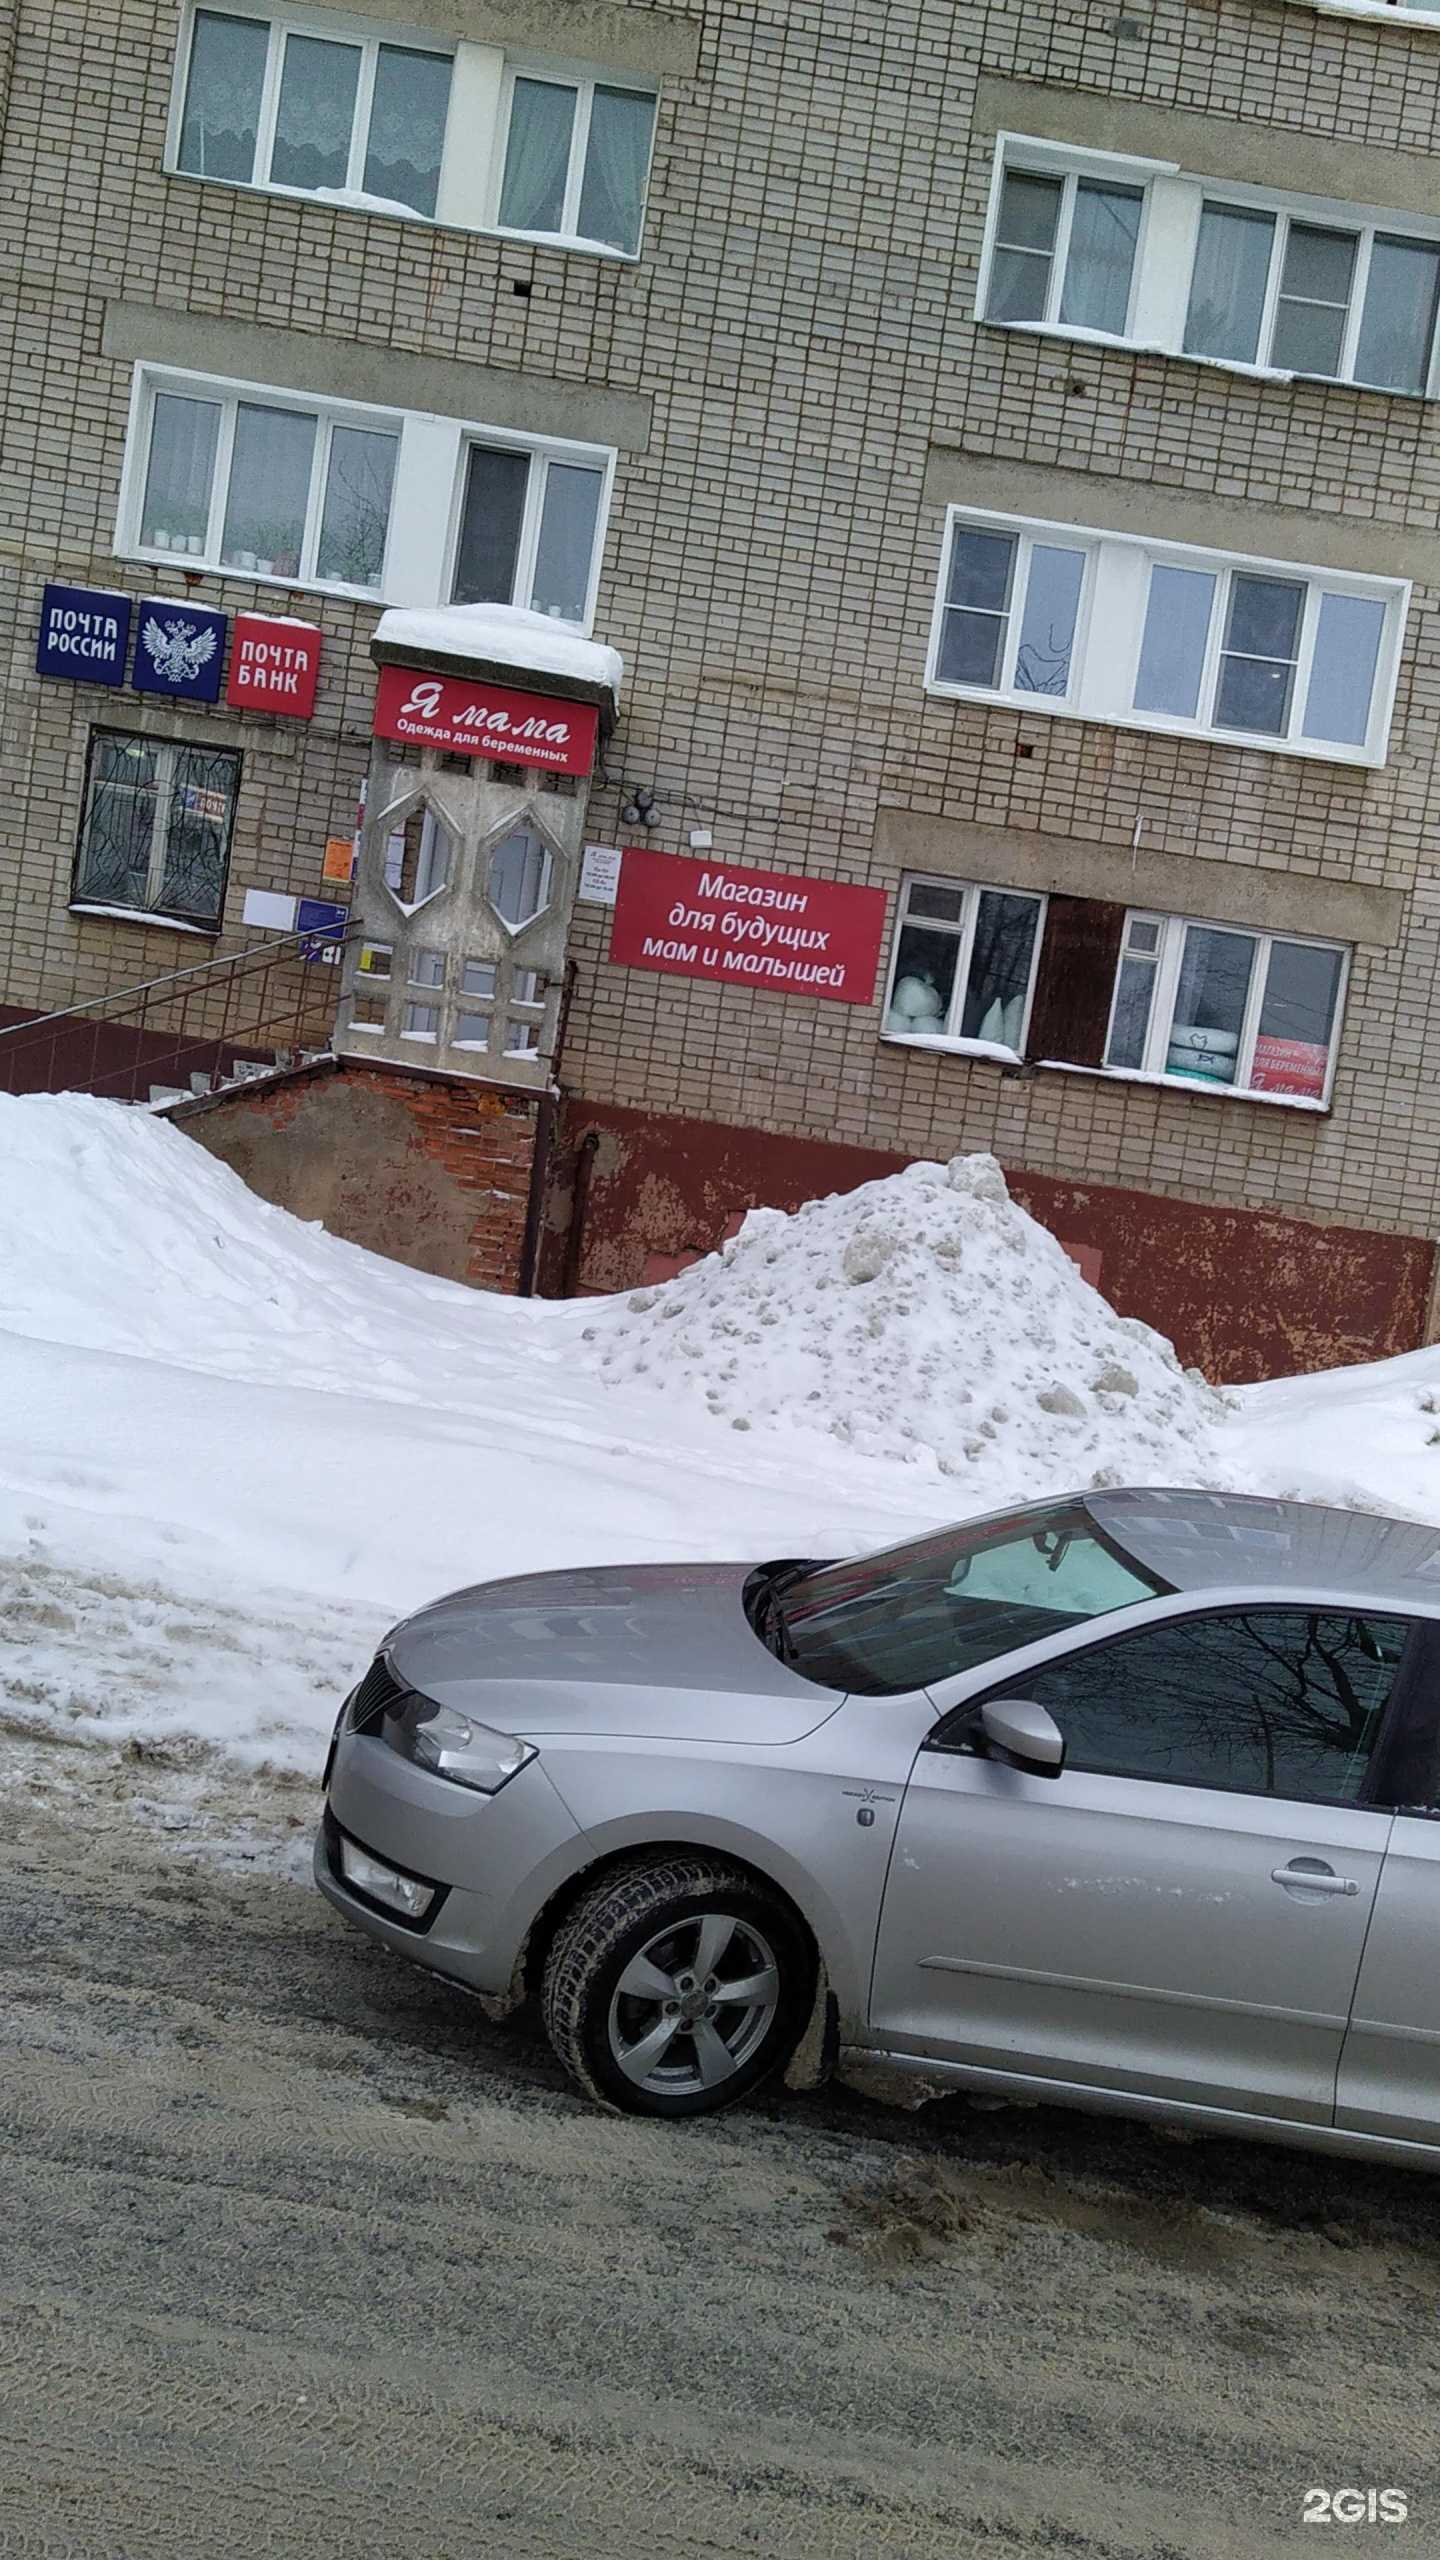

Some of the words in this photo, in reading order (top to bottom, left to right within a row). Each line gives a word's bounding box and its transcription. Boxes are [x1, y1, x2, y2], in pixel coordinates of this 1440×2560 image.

[49, 608, 118, 639] ПОЧТА
[47, 631, 116, 661] РОССИИ
[241, 641, 308, 672] ПОЧТА
[238, 666, 298, 694] БАНК
[400, 682, 443, 718] Я
[452, 704, 571, 744] мама
[396, 718, 451, 740] Одежда
[454, 732, 480, 746] для
[482, 736, 568, 763] беременных
[698, 873, 808, 913] Магазин
[668, 902, 716, 931] для
[721, 912, 830, 951] будущих
[642, 937, 697, 963] мам
[702, 948, 718, 966] и
[723, 952, 847, 986] малышей
